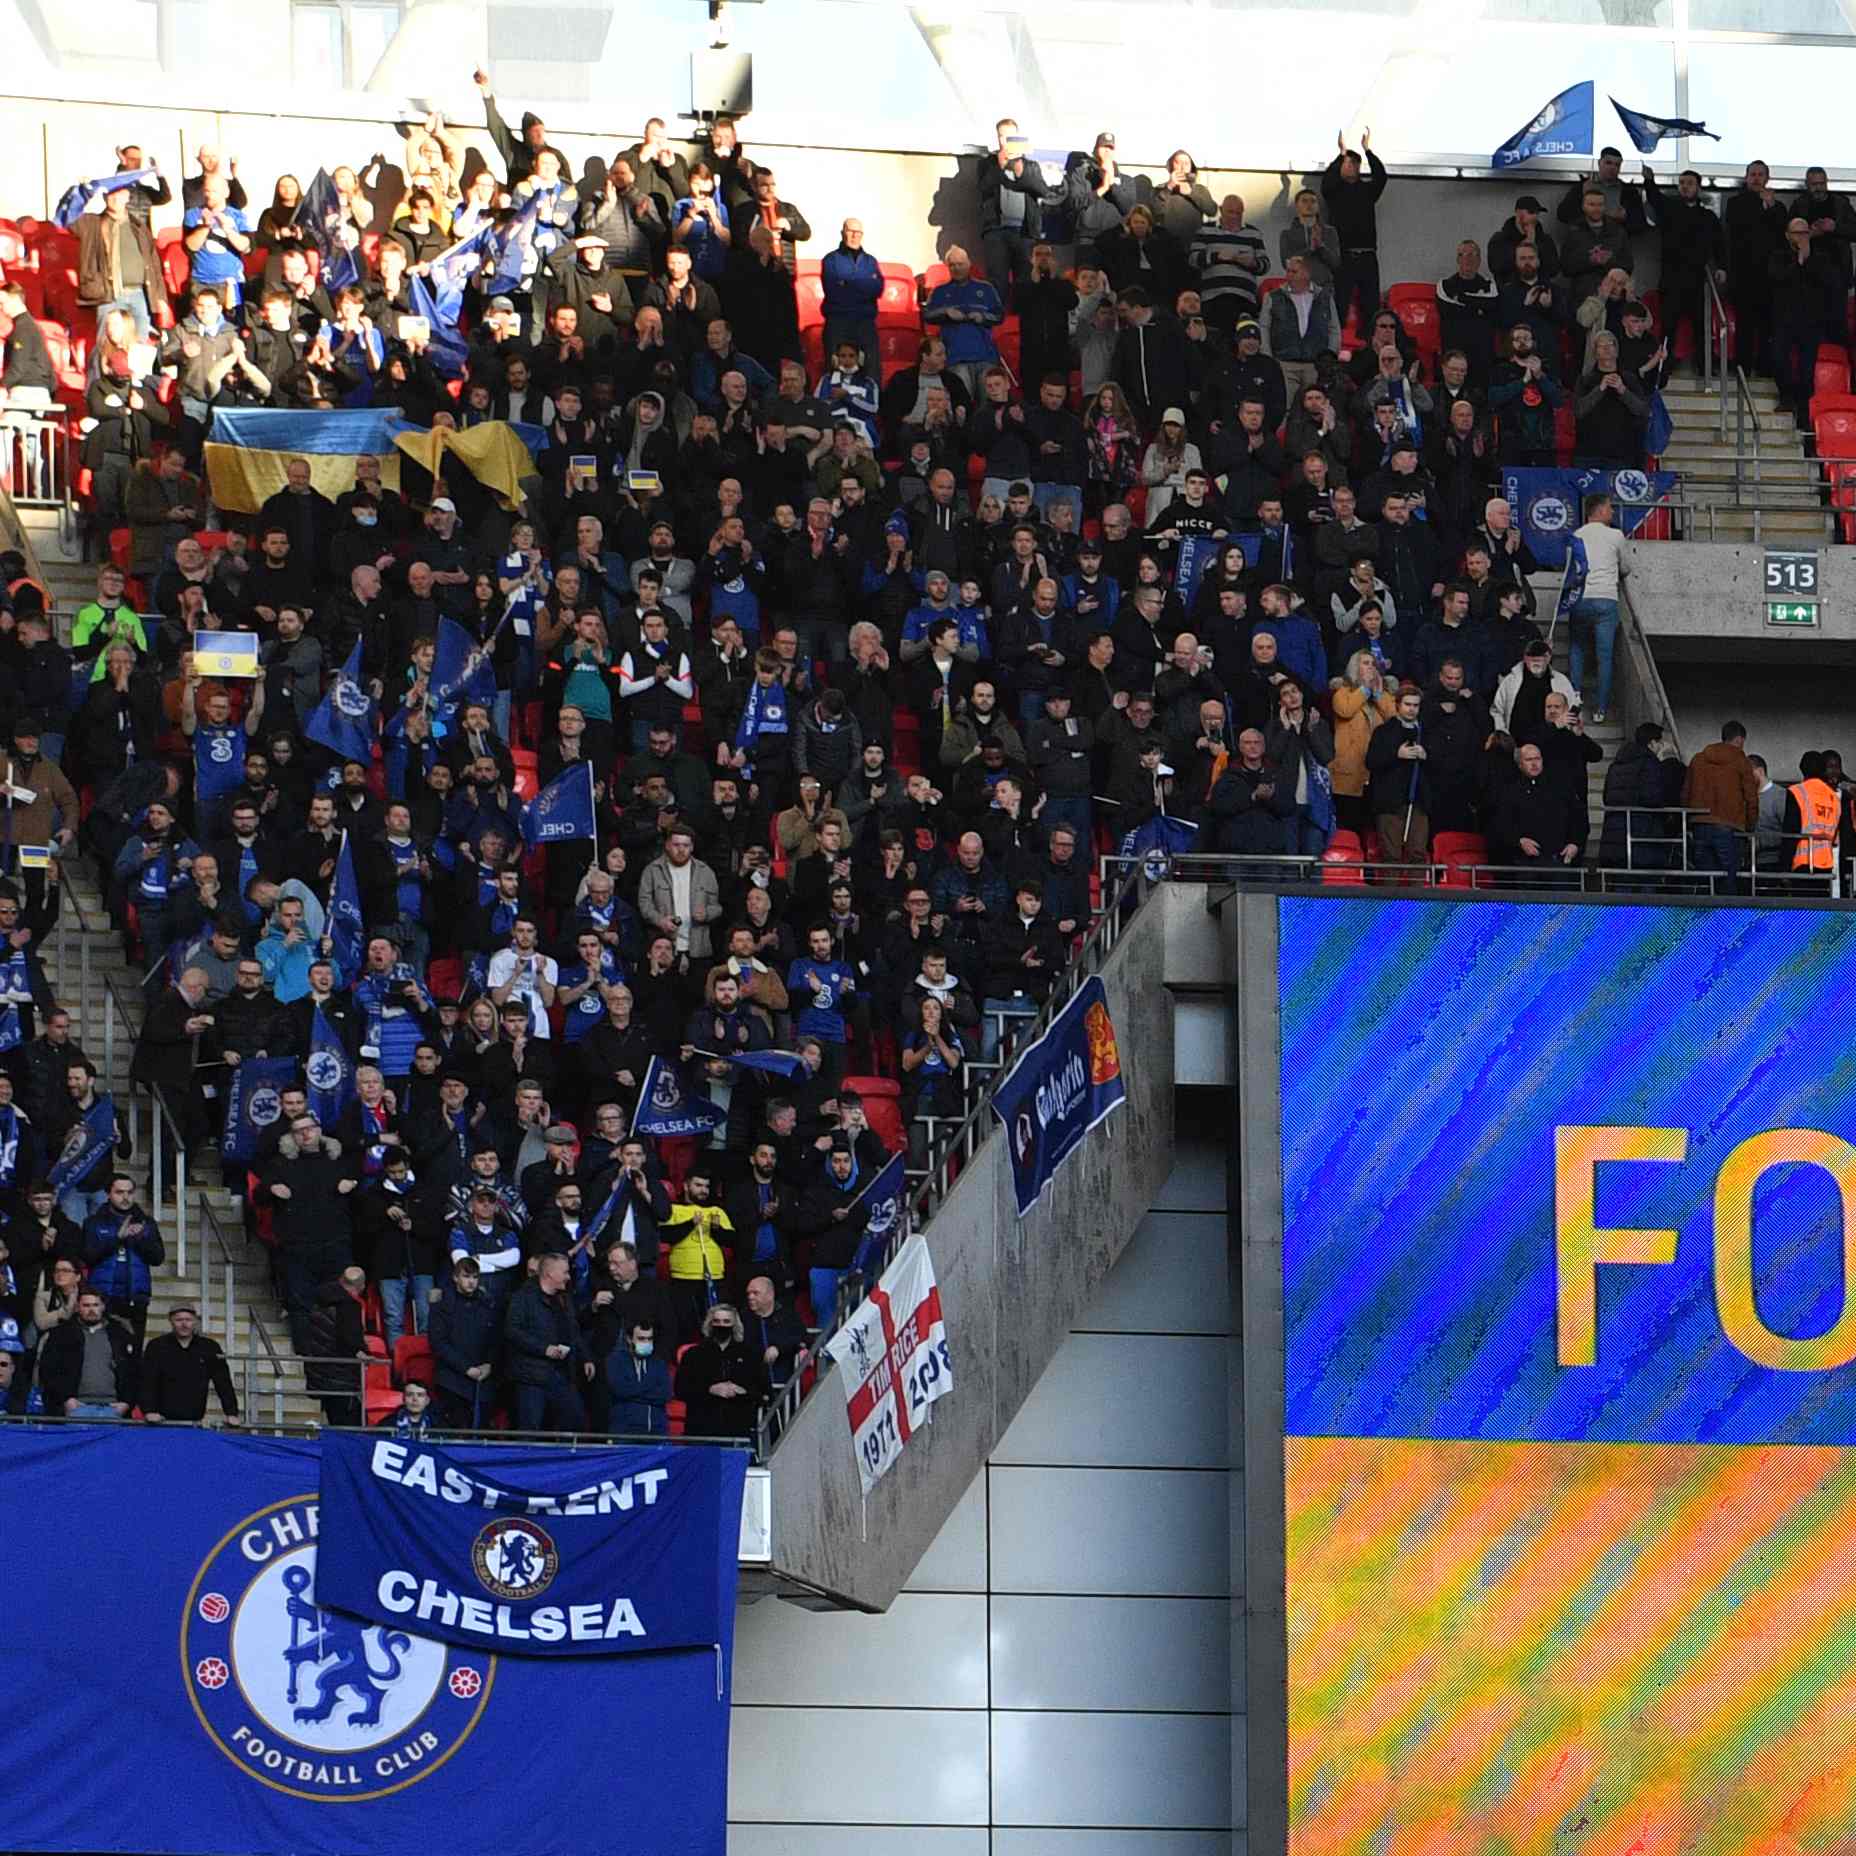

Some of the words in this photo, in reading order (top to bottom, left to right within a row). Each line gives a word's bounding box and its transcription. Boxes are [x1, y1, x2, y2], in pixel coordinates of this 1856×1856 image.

[1766, 562, 1815, 588] 513
[639, 1117, 693, 1135] CHELSEA
[695, 1115, 716, 1129] FC
[892, 1317, 921, 1367] RICE
[863, 1406, 902, 1475] 1971
[371, 1440, 509, 1510] EAST
[378, 1569, 648, 1642] CHELSEA
[232, 1725, 364, 1786] FOOTBALL
[375, 1731, 440, 1777] CLUB
